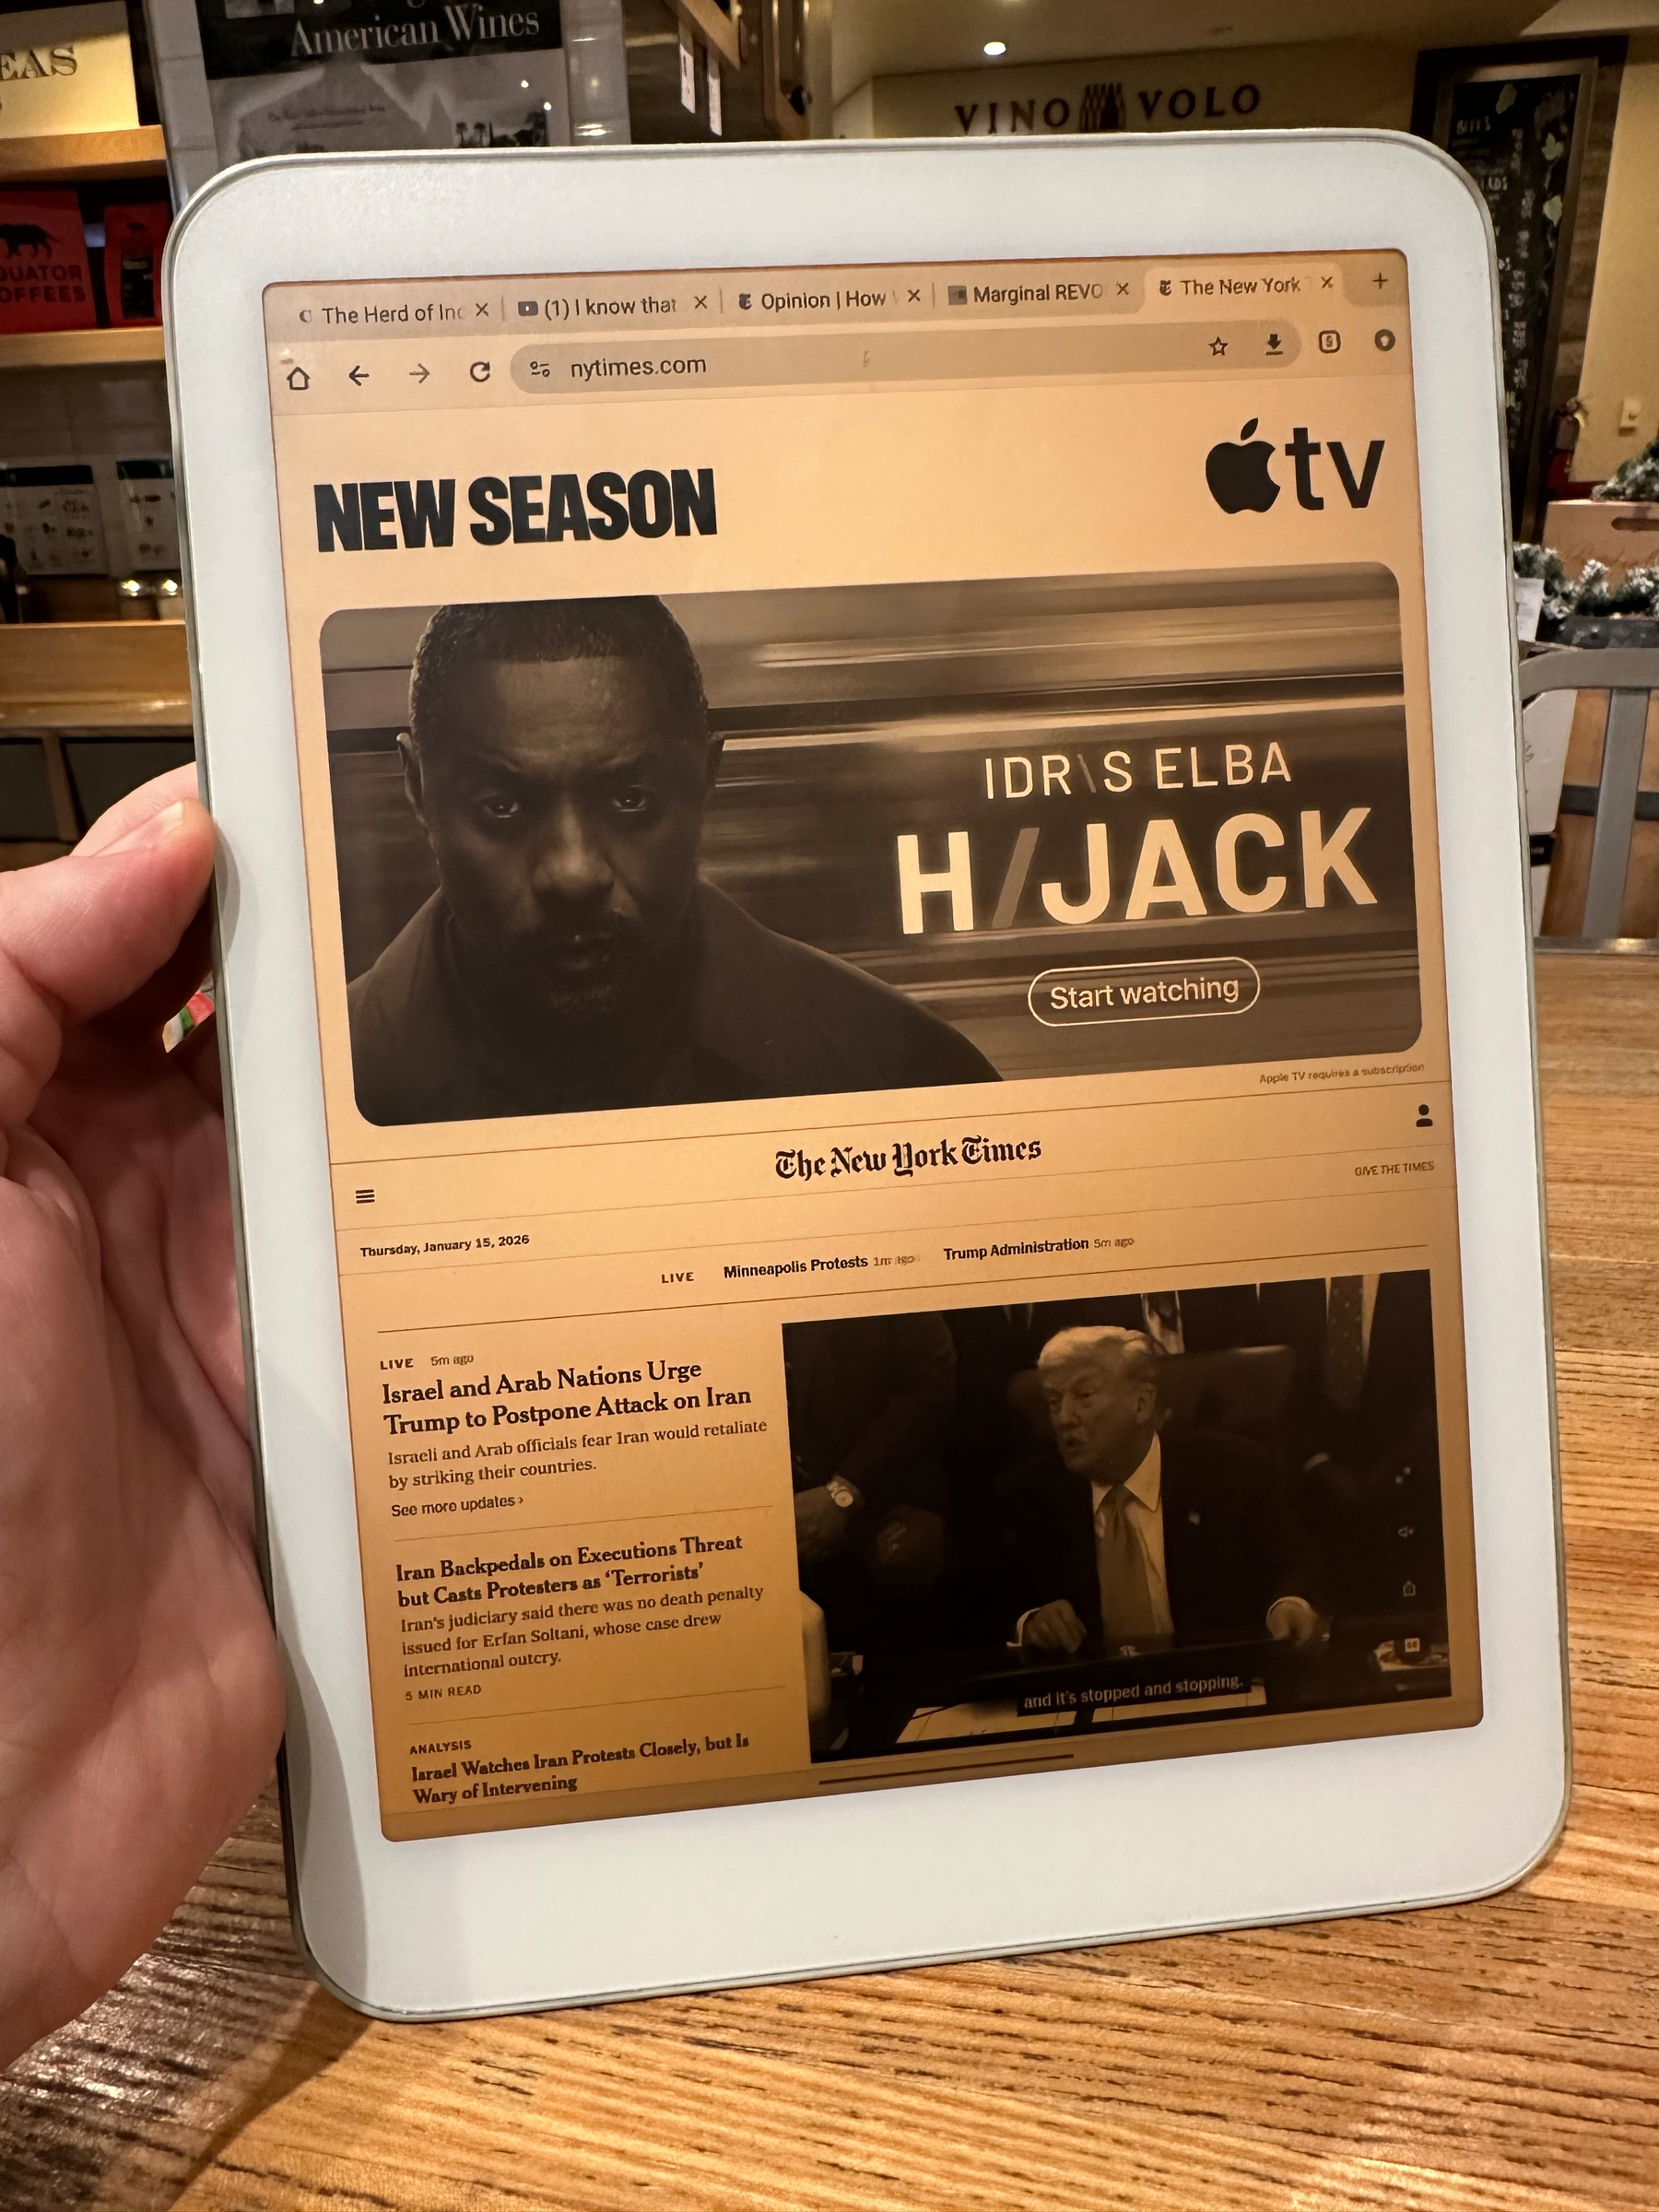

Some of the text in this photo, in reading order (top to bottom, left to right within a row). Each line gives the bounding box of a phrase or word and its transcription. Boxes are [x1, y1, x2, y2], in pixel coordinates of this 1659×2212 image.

[290, 4, 540, 57] American Wines
[955, 84, 1261, 135] VINO VOLO
[761, 291, 830, 312] Opinion
[846, 289, 887, 308] How
[973, 283, 1103, 305] Marginal REVO
[1180, 278, 1214, 296] The
[1219, 278, 1257, 295] New
[1262, 276, 1301, 294] York
[322, 307, 359, 324] The
[364, 304, 408, 323] Herd
[415, 303, 434, 322] of
[544, 299, 570, 321] (1)
[585, 298, 635, 315] know
[571, 357, 707, 382] nytimes.com
[1285, 427, 1385, 511] tv
[313, 468, 717, 552] NEW SEASON
[1154, 741, 1291, 790] ELBA
[1050, 976, 1240, 1009] Start watching
[1259, 1072, 1288, 1085] Apple
[1292, 1071, 1305, 1081] TV
[775, 1135, 1041, 1181] The New York Times
[1382, 1163, 1400, 1175] THE
[1403, 1160, 1435, 1173] TIMES
[359, 1234, 530, 1257] Thursday, January 15, 2026
[944, 1247, 987, 1261] Trump
[990, 1238, 1089, 1257] Administration
[662, 1272, 694, 1284] LIVE
[724, 1260, 807, 1278] Minneapolis
[810, 1255, 868, 1272] Protests
[380, 1358, 414, 1370] LIVE
[430, 1356, 450, 1366] 5m
[382, 1360, 701, 1404] Israel and Arab Nations Urge
[383, 1386, 751, 1435] Trump to Postpone Attack on Iran
[388, 1419, 768, 1465] Israeli and Arab officials fear Iran would retaliate
[389, 1458, 596, 1490] by striking their countries.
[392, 1495, 516, 1517] See more updates
[395, 1535, 743, 1582] Iran Backpedals on Executions Threat
[397, 1590, 429, 1607] but
[433, 1586, 482, 1604] Casts
[487, 1579, 578, 1599] Protesters
[582, 1577, 601, 1590] as
[448, 1610, 518, 1632] judiciary
[521, 1605, 554, 1621] said
[559, 1602, 598, 1617] there
[603, 1599, 633, 1613] was
[637, 1596, 656, 1609] no
[660, 1591, 703, 1607] death
[707, 1585, 764, 1606] penalty
[402, 1614, 721, 1655] issued for Erfan Soltani, whose case drew
[404, 1652, 561, 1678] international outcry.
[406, 1684, 482, 1701] 5 MIN READ
[1024, 1692, 1052, 1709] and
[1080, 1684, 1139, 1703] stopped
[1144, 1680, 1171, 1697] and
[1175, 1675, 1243, 1693] stopping.
[409, 1739, 472, 1755] ANALYSIS
[412, 1733, 749, 1783] Israel Watches Iran Protests Closely, but Is
[412, 1774, 578, 1805] Wary of Intervening
